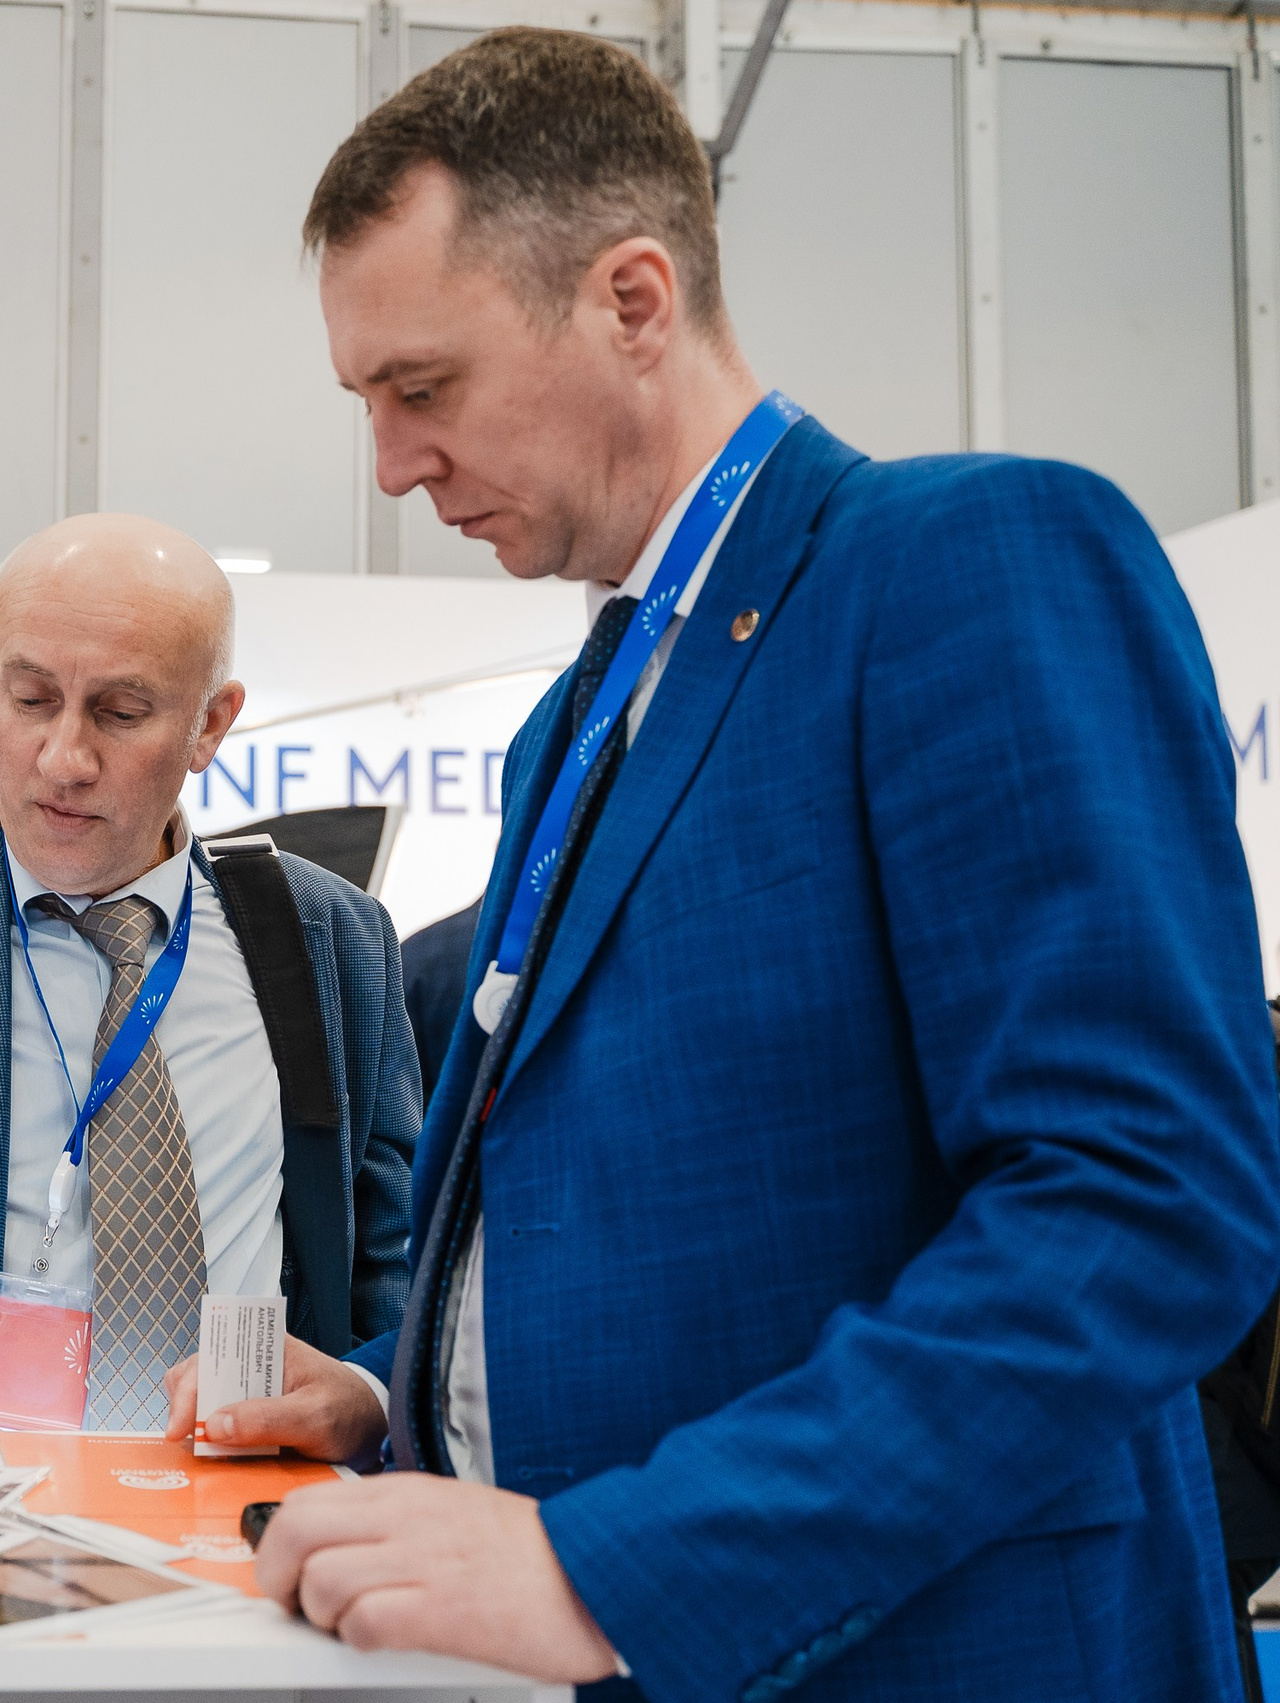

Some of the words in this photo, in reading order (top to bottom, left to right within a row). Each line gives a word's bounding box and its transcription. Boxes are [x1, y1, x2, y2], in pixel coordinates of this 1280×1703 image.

[255, 1307, 265, 1373] АНАТОЛЬЕВИЧ
[265, 1307, 275, 1362] ДЕМЕНТЬЕВ
[264, 1364, 272, 1397] МИХАИ
